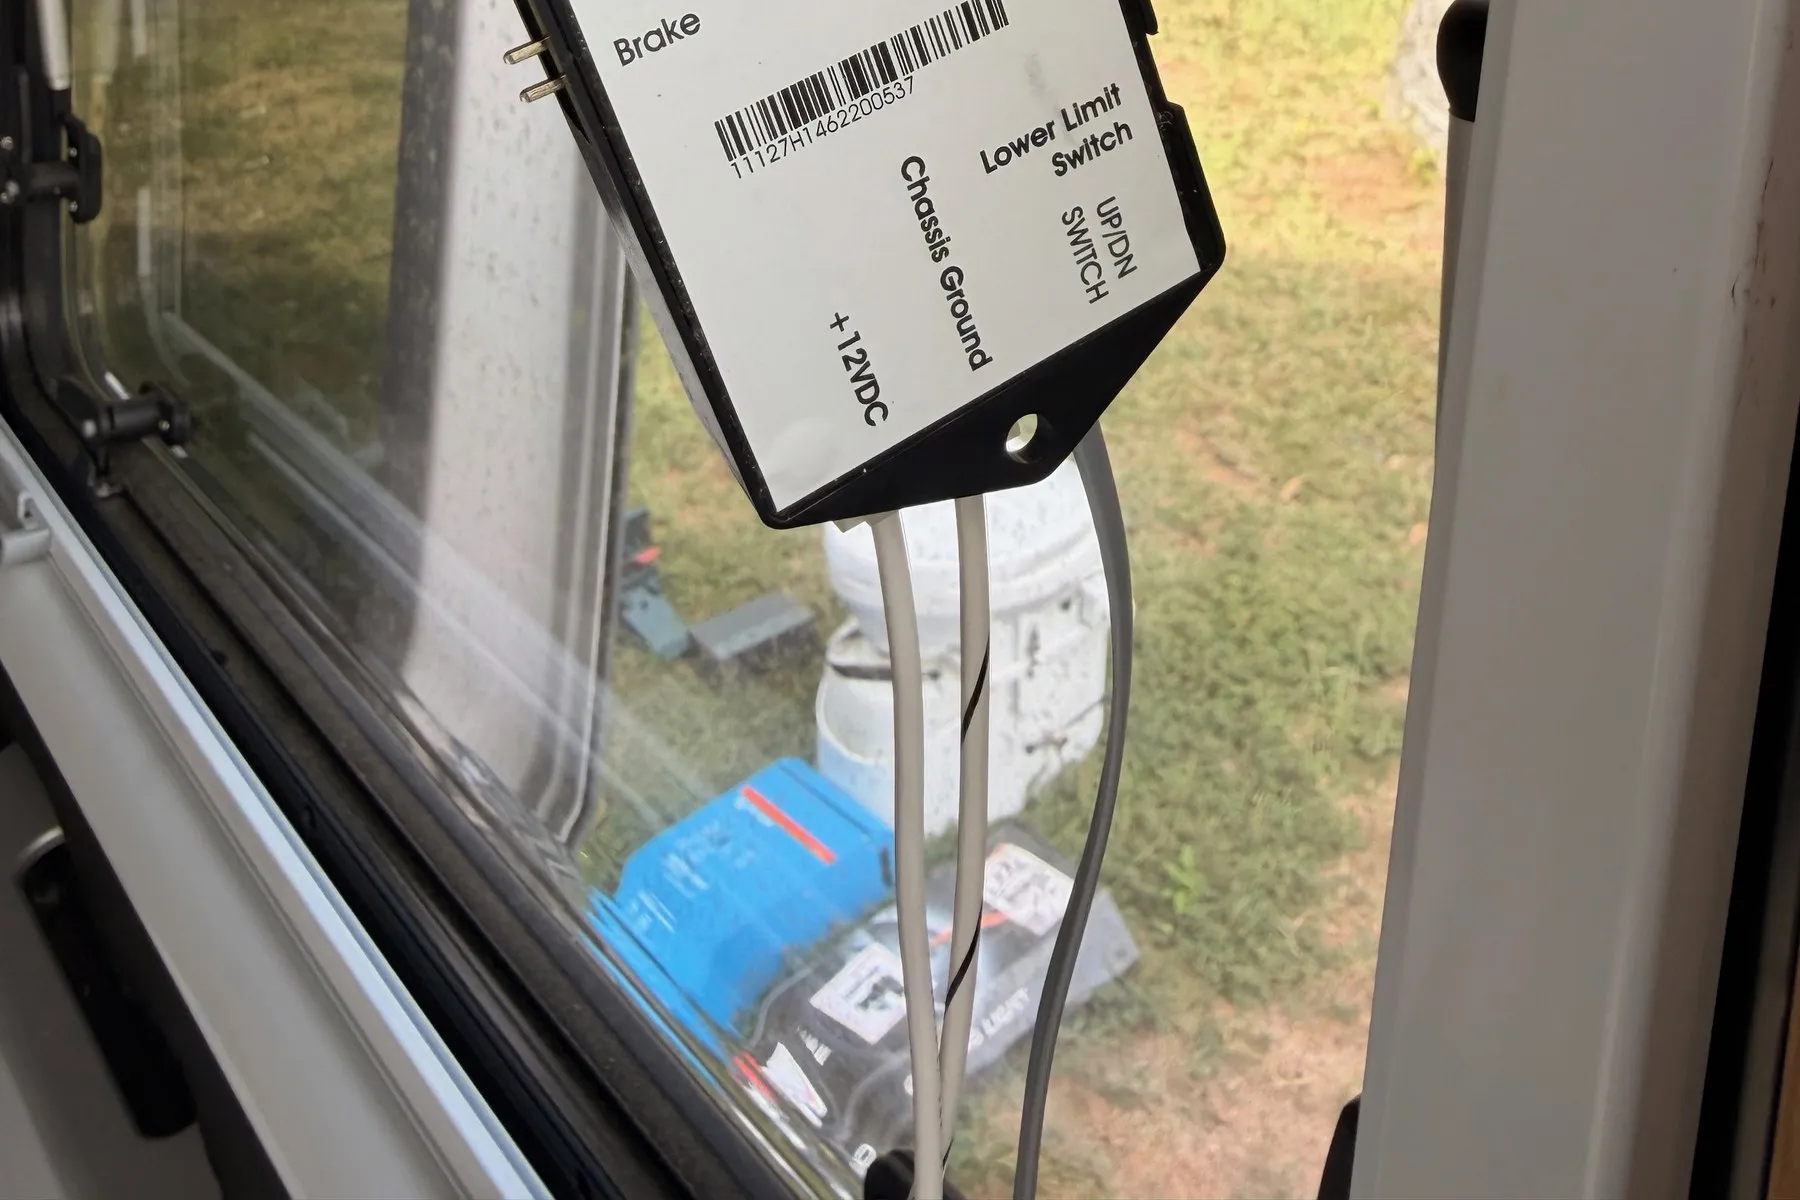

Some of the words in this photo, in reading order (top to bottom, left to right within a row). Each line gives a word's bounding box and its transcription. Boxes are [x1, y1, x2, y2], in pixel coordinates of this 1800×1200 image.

[613, 13, 701, 67] Brake
[730, 75, 915, 179] 11127H1462200537
[979, 119, 1056, 175] Lower
[1060, 82, 1122, 132] Limit
[1051, 121, 1133, 177] Switch
[900, 155, 952, 263] Chassis
[939, 265, 994, 372] Ground
[1061, 206, 1110, 305] SWITCH
[1096, 195, 1138, 280] UP/DN
[829, 312, 889, 427] +12VDC
